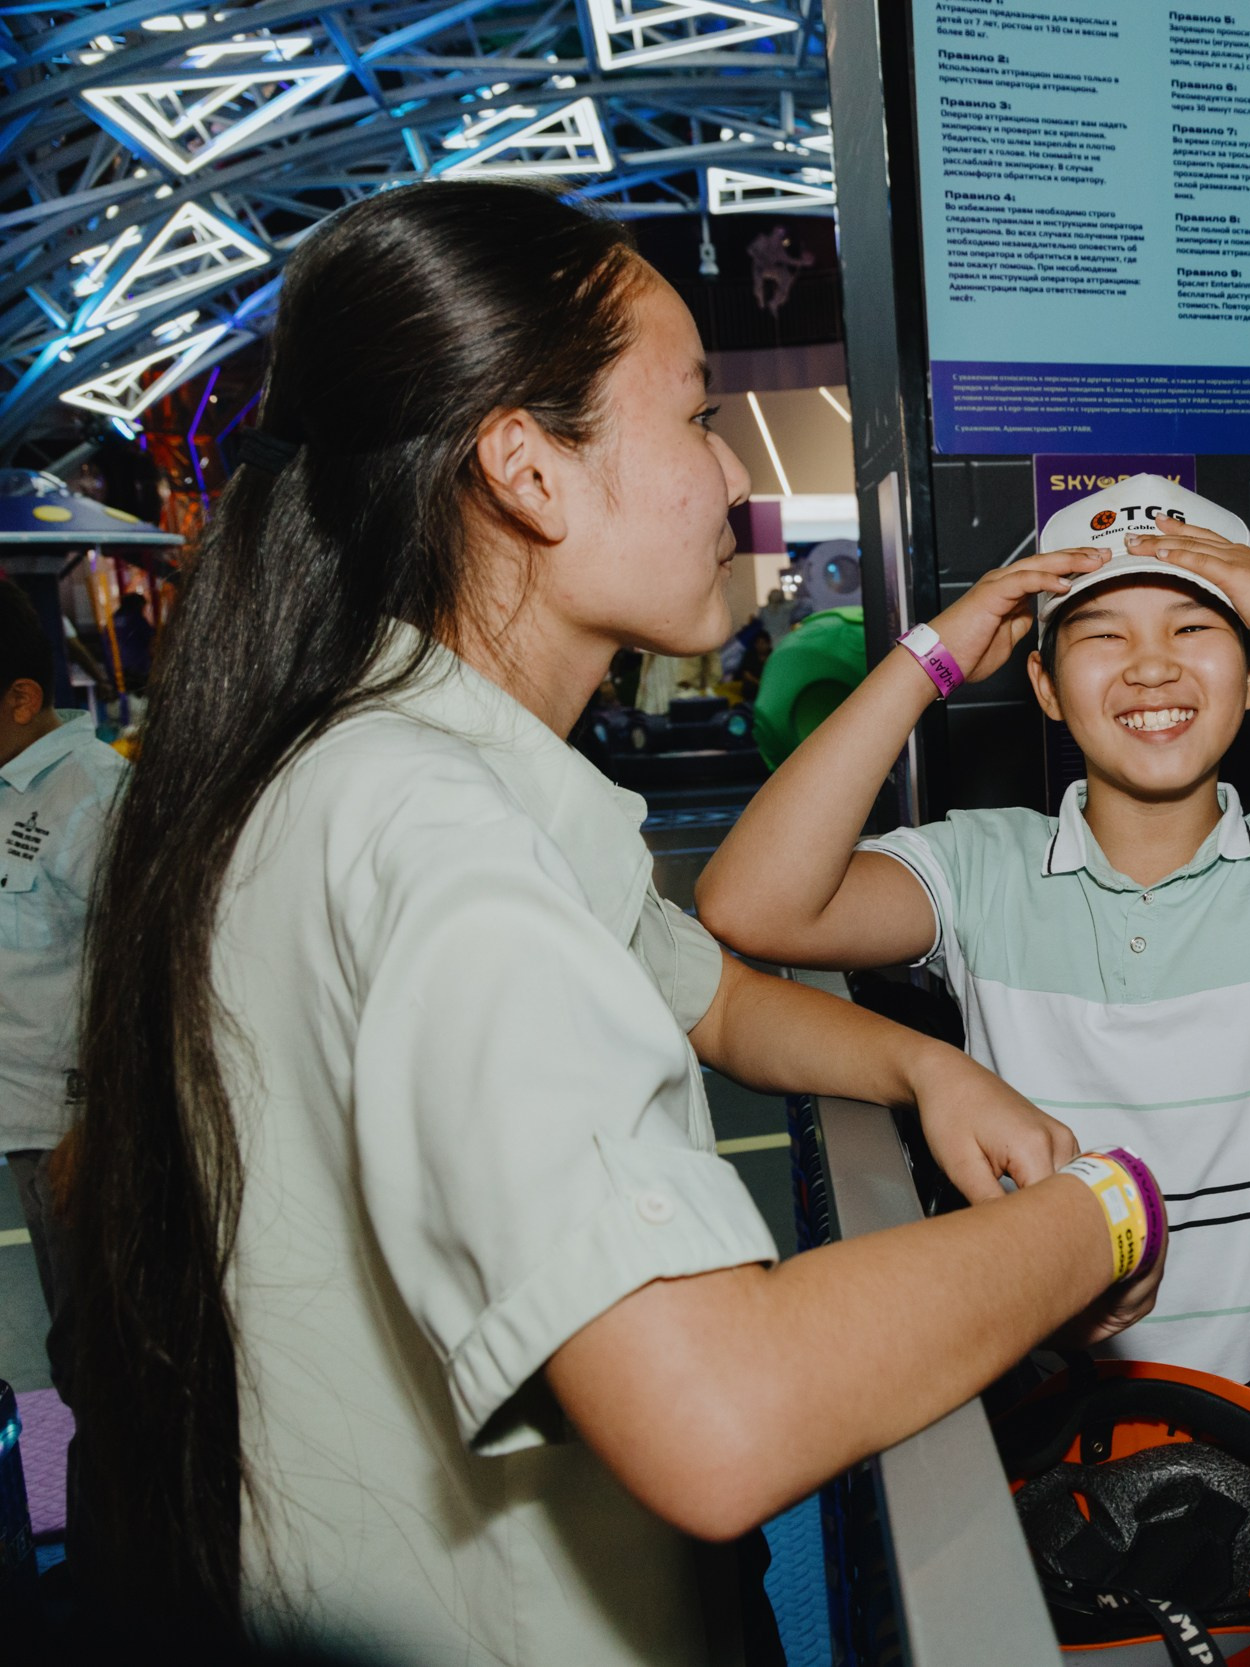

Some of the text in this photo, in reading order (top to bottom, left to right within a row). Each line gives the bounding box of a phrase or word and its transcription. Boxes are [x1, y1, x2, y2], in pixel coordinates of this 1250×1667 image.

[1168, 10, 1221, 23] Правило
[937, 48, 1009, 64] Правило 2:
[1170, 78, 1223, 91] Правило
[939, 96, 1011, 110] Правило 3:
[1171, 123, 1224, 135] Правило
[944, 189, 1016, 202] Правило 4:
[1174, 212, 1227, 223] Правило
[1176, 266, 1228, 277] Правило
[1050, 474, 1093, 491] SKY
[1120, 505, 1187, 524] TCG
[1090, 527, 1124, 541] Techno
[1146, 1596, 1215, 1666] AMP
